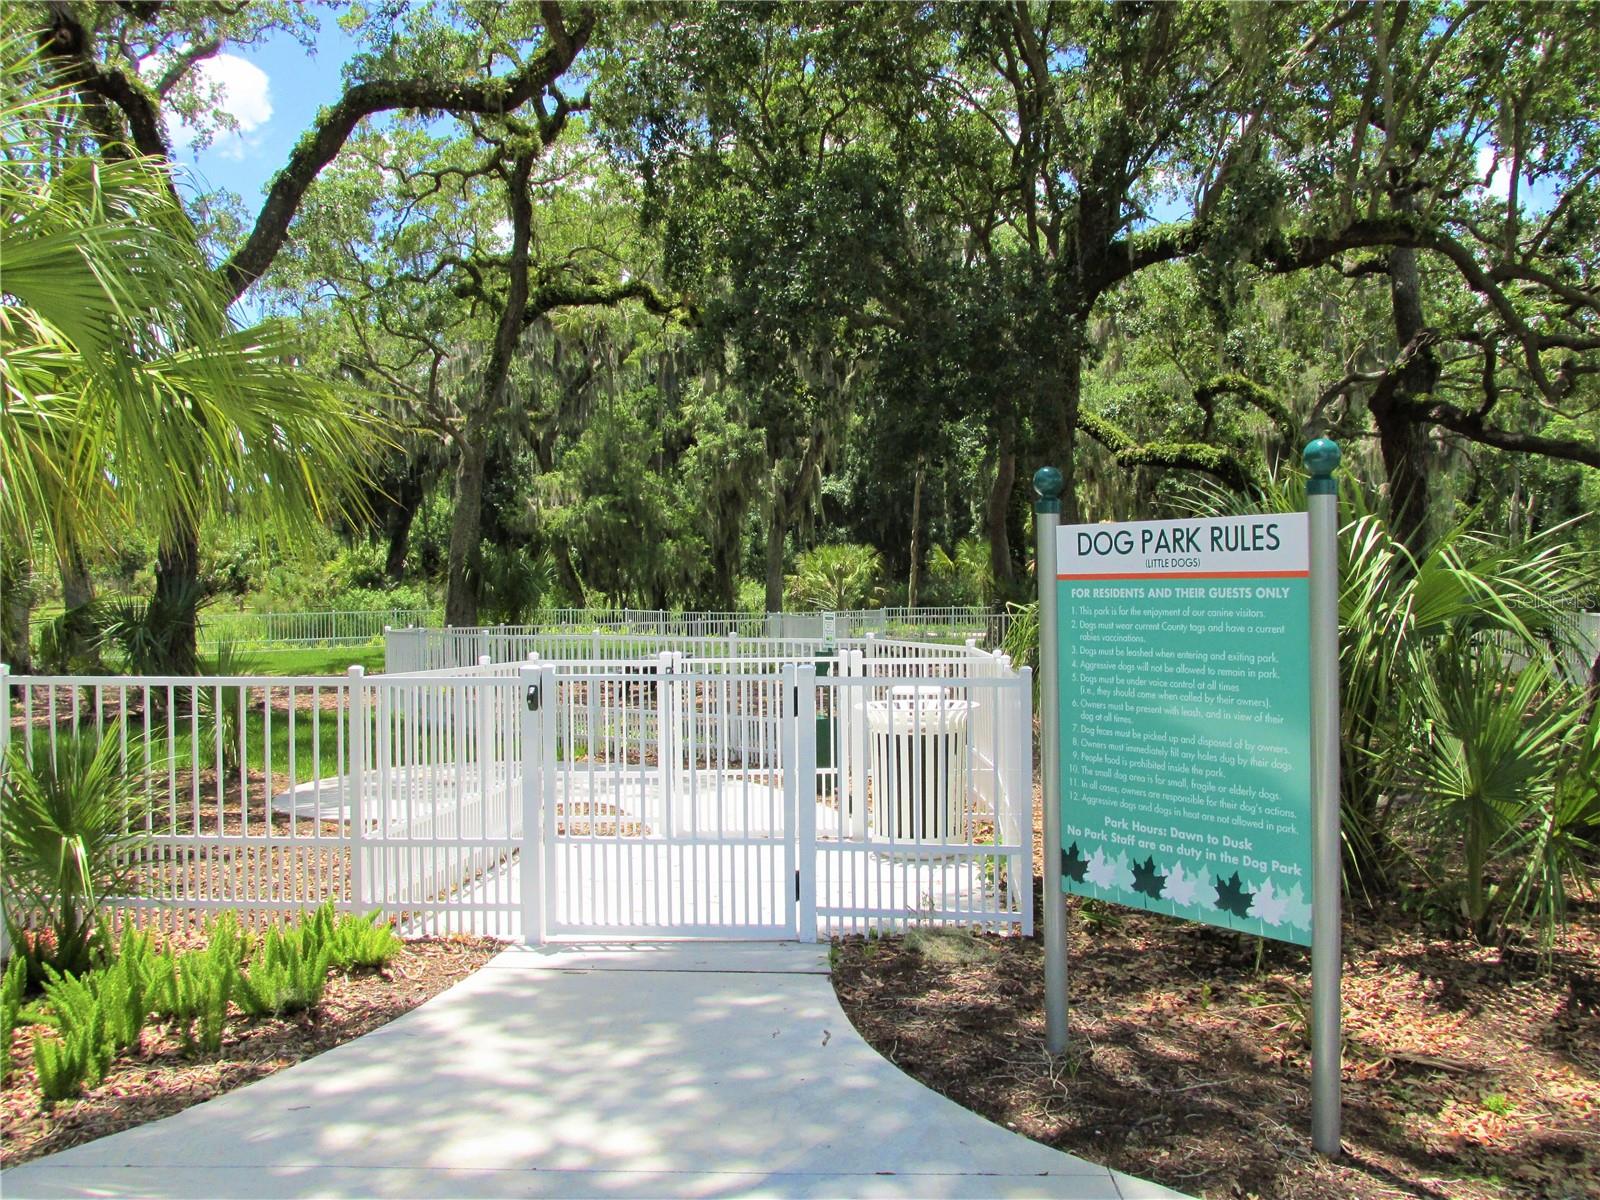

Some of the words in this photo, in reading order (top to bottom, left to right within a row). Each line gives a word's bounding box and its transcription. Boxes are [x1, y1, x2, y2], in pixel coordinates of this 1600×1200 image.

[1078, 530, 1134, 556] DOG
[1142, 527, 1202, 554] PARK
[1210, 524, 1280, 552] RULES
[1146, 558, 1169, 568] (LITTLE
[1170, 558, 1200, 568] DOGS)
[1072, 588, 1090, 598] FOR
[1092, 588, 1144, 598] RESIDENTS
[1148, 588, 1172, 598] AND
[1174, 588, 1206, 598] THEIR
[1209, 587, 1251, 598] GUESTS
[1255, 587, 1290, 598] ONLY
[1080, 606, 1092, 616] This
[1094, 606, 1110, 617] park
[1119, 606, 1128, 616] for
[1130, 606, 1141, 616] the
[1143, 608, 1180, 618] enjoyment
[1182, 606, 1190, 616] of
[1207, 608, 1234, 616] canine
[1236, 608, 1266, 618] visitors.
[1080, 620, 1096, 631] Dogs
[1162, 622, 1188, 633] County
[1190, 624, 1205, 634] tags
[1208, 621, 1224, 632] and
[1225, 622, 1245, 632] have
[1255, 625, 1285, 634] current
[1080, 632, 1100, 640] rabies
[1102, 634, 1146, 642] vaccinations.
[1080, 646, 1096, 656] Dogs
[1116, 646, 1124, 656] be
[1126, 646, 1153, 657] leashed
[1155, 648, 1175, 658] when
[1176, 650, 1208, 662] entering
[1210, 650, 1226, 660] and
[1228, 652, 1255, 664] exiting
[1258, 652, 1279, 664] park.
[1080, 660, 1116, 671] Aggressive
[1118, 660, 1135, 672] dogs
[1136, 662, 1149, 672] will
[1150, 664, 1162, 672] not
[1164, 662, 1174, 672] be
[1176, 664, 1206, 674] allowed
[1208, 666, 1216, 676] to
[1218, 668, 1245, 677] remain
[1248, 668, 1256, 677] in
[1258, 668, 1280, 680] park.
[1080, 674, 1096, 685] Dogs
[1116, 674, 1124, 684] be
[1126, 676, 1146, 686] under
[1148, 679, 1168, 687] voice
[1170, 678, 1196, 688] control
[1207, 680, 1216, 690] all
[1219, 682, 1240, 692] times
[1097, 686, 1110, 698] they
[1113, 687, 1136, 698] should
[1158, 690, 1178, 700] when
[1180, 691, 1202, 702] called
[1205, 692, 1215, 705] by
[1216, 694, 1234, 704] their
[1236, 698, 1271, 709] owners).
[1080, 700, 1106, 709] Owners
[1108, 703, 1124, 711] must
[1125, 702, 1135, 712] be
[1136, 705, 1162, 714] present
[1163, 706, 1180, 716] with
[1182, 706, 1204, 718] leash,
[1206, 708, 1221, 718] and
[1224, 711, 1230, 719] in
[1233, 712, 1252, 720] view
[1254, 712, 1262, 722] of
[1265, 713, 1284, 724] their
[1080, 711, 1094, 722] dog
[1104, 712, 1112, 721] all
[1114, 714, 1133, 724] times.
[1080, 725, 1094, 736] Dog
[1115, 729, 1130, 738] must
[1132, 728, 1141, 738] be
[1144, 730, 1166, 742] picked
[1169, 736, 1178, 744] up
[1180, 734, 1196, 744] and
[1198, 736, 1232, 750] disposed
[1234, 738, 1242, 748] of
[1244, 740, 1255, 752] by
[1257, 745, 1290, 754] owners.
[1081, 738, 1106, 748] Owners
[1126, 744, 1168, 758] immediately
[1170, 746, 1180, 757] fill
[1181, 752, 1195, 761] any
[1198, 750, 1217, 761] holes
[1220, 752, 1235, 766] dug
[1238, 754, 1248, 767] by
[1250, 756, 1270, 768] their
[1271, 758, 1294, 772] dogs.
[1082, 752, 1104, 764] People
[1105, 754, 1120, 765] food
[1130, 758, 1165, 770] prohibited
[1168, 762, 1189, 773] inside
[1192, 764, 1202, 775] the
[1205, 768, 1226, 778] park.
[1082, 766, 1092, 776] The
[1095, 768, 1112, 777] small
[1114, 770, 1127, 782] dog
[1155, 774, 1165, 784] for
[1168, 778, 1188, 790] small,
[1192, 780, 1216, 792] fragile
[1229, 784, 1256, 799] elderly
[1258, 787, 1280, 802] dogs.
[1099, 784, 1119, 793] cases,
[1121, 788, 1146, 796] owners
[1162, 792, 1204, 805] responsible
[1206, 796, 1216, 807] for
[1220, 798, 1238, 809] their
[1240, 800, 1262, 815] dog's
[1264, 807, 1296, 818] actions.
[1082, 794, 1118, 806] Aggressive
[1120, 798, 1136, 812] dogs
[1138, 802, 1152, 812] and
[1154, 804, 1172, 816] dogs
[1182, 807, 1200, 818] heat
[1216, 816, 1230, 824] not
[1232, 816, 1264, 829] allowed
[1266, 822, 1274, 830] in
[1276, 823, 1298, 834] park.
[1104, 816, 1128, 830] Park
[1132, 821, 1167, 836] Hours:
[1170, 827, 1203, 842] Dawn
[1207, 834, 1218, 844] to
[1222, 836, 1252, 850] Dusk
[1067, 824, 1082, 836] No
[1084, 828, 1108, 841] Park
[1112, 832, 1136, 846] Staff
[1138, 842, 1156, 850] are
[1176, 844, 1202, 860] duty
[1206, 848, 1216, 860] in
[1220, 851, 1239, 864] the
[1242, 856, 1268, 872] Dog
[1272, 860, 1302, 876] Park
